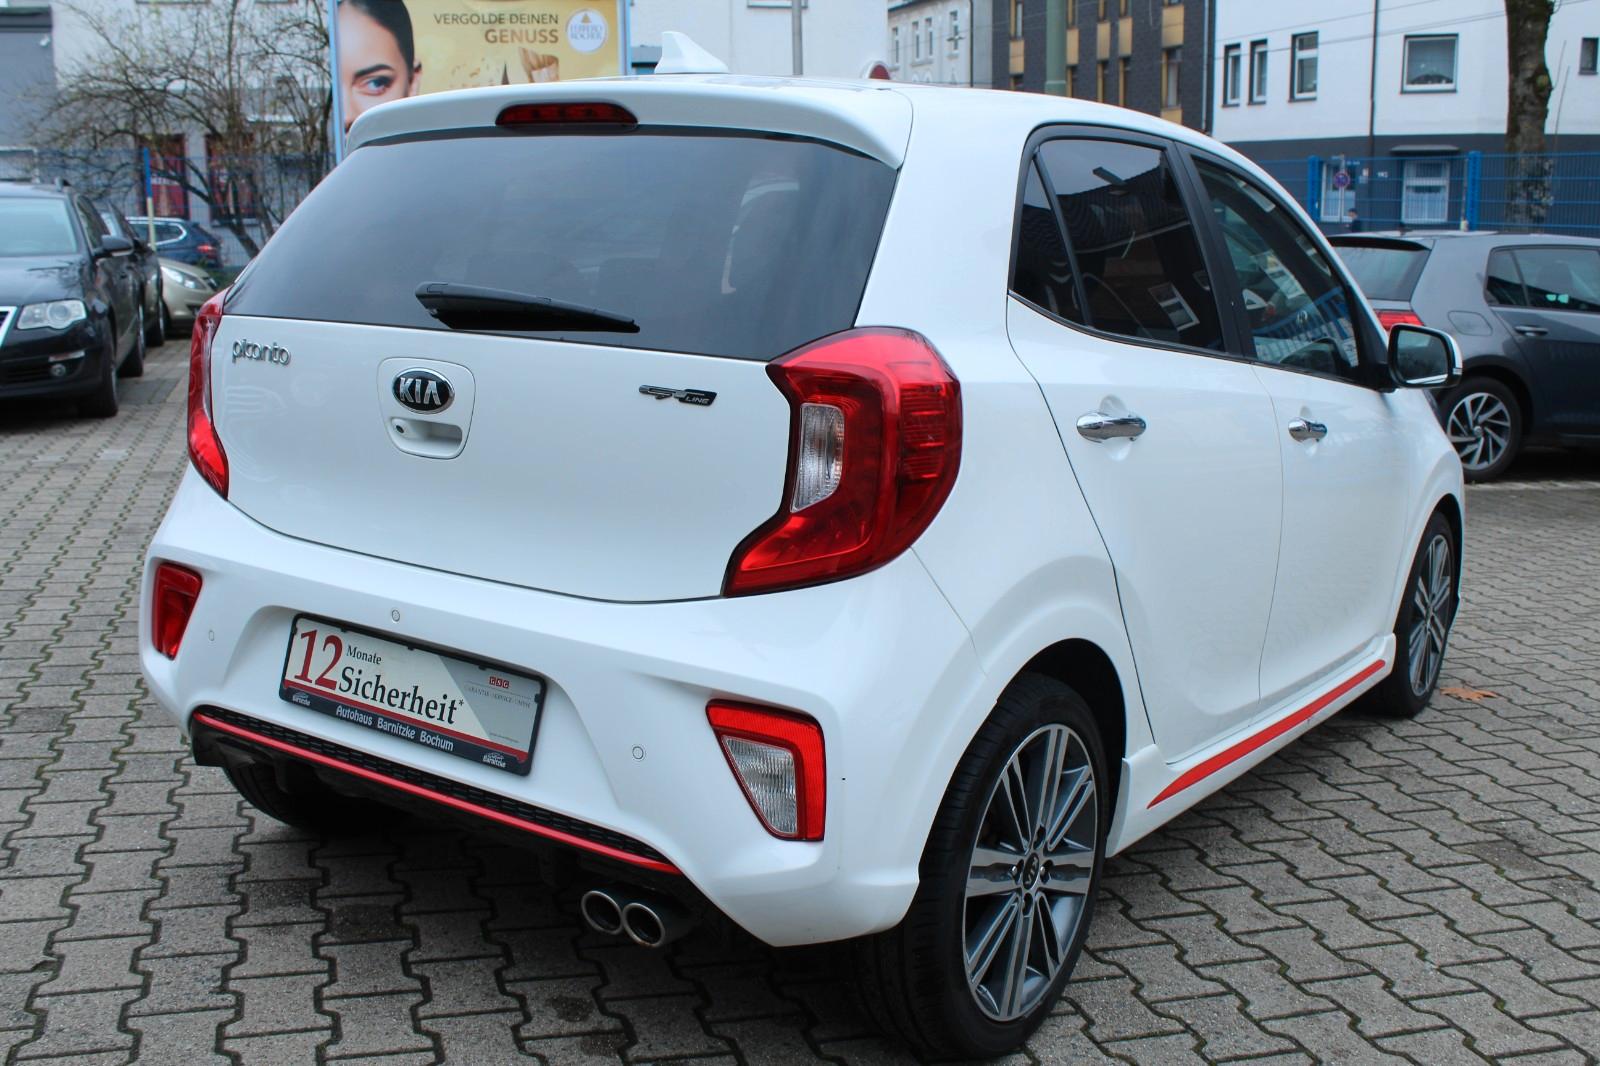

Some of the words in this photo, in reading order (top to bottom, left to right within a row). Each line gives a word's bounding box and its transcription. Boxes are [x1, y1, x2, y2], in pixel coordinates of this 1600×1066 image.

[434, 13, 505, 25] VERGOLDE
[509, 13, 559, 25] DEINEN
[484, 29, 559, 44] GENUSS
[232, 339, 291, 365] picanto
[400, 377, 442, 405] KIA
[294, 629, 343, 690] 12
[346, 645, 382, 664] Monate
[336, 705, 373, 726] Autohaus
[377, 717, 416, 739] Barnitzke
[420, 730, 454, 752] Bochum
